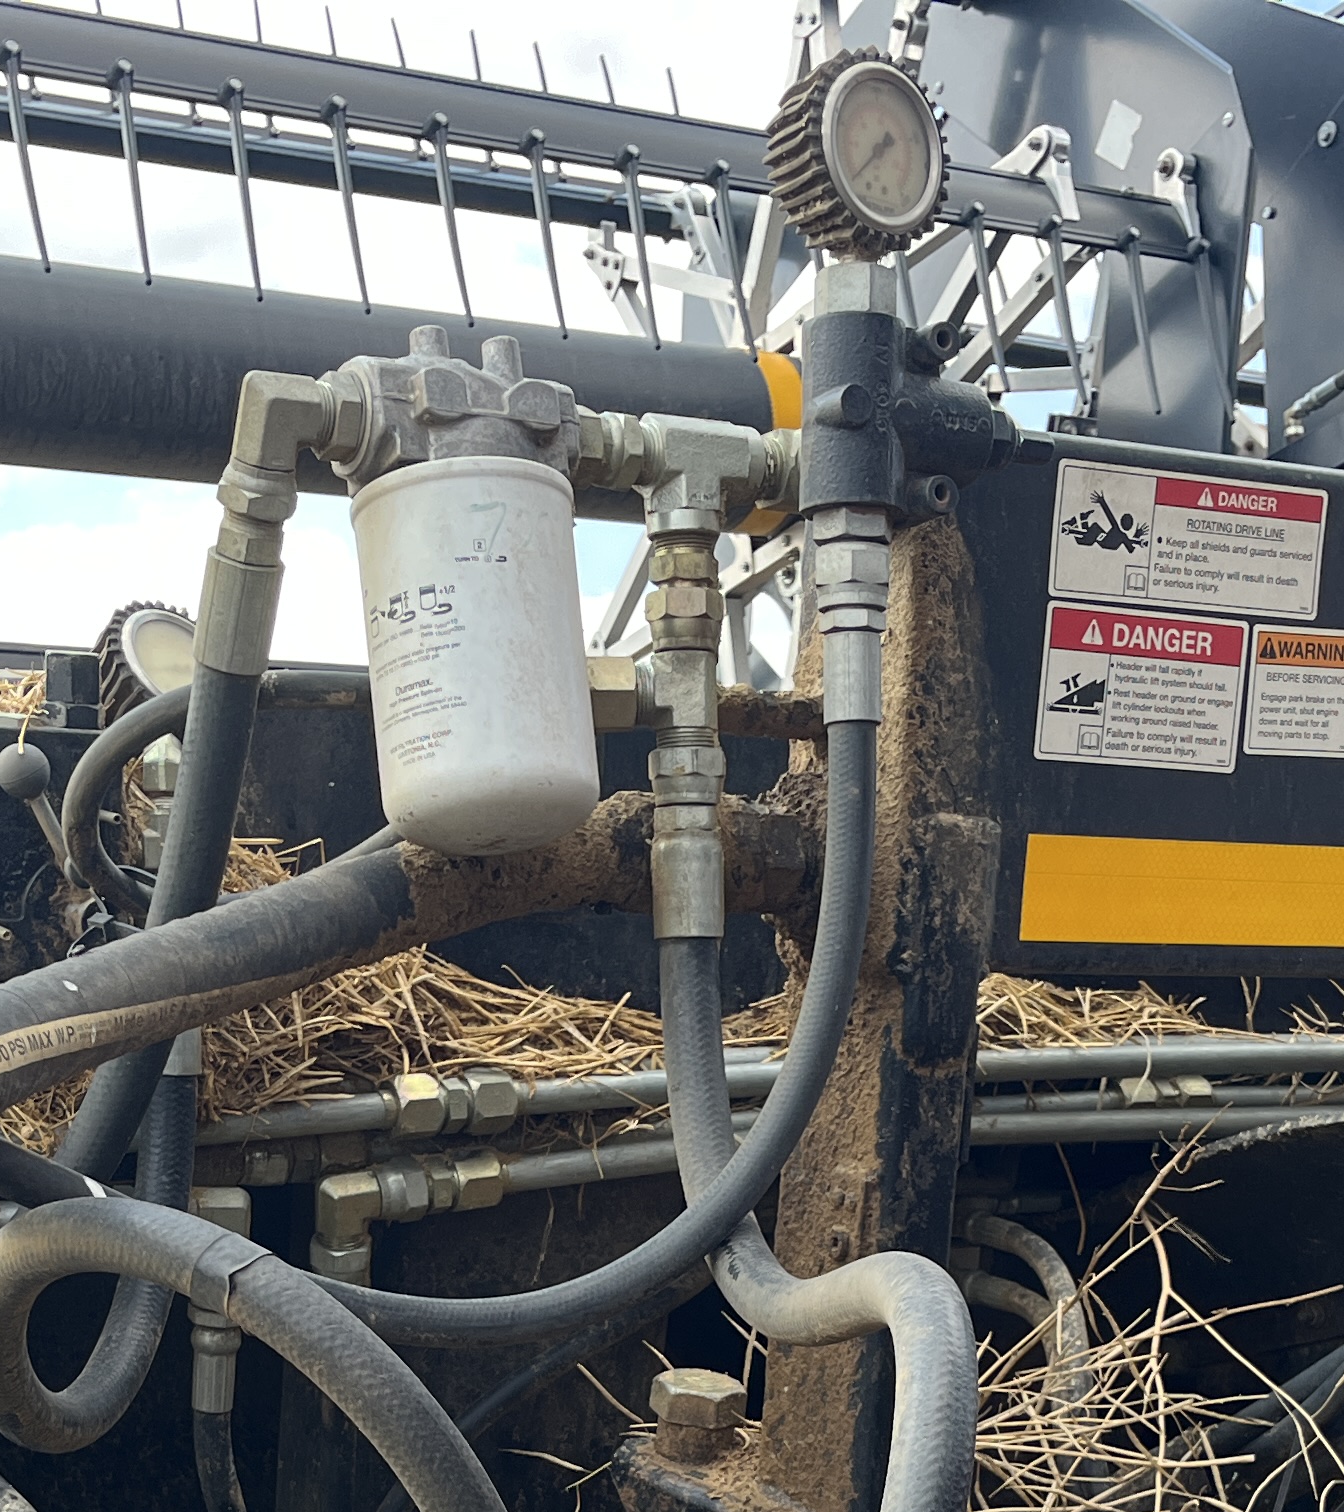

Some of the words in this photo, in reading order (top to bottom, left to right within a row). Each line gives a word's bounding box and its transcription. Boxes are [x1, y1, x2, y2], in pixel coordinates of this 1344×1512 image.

[1217, 490, 1278, 513] DANGER
[1185, 518, 1233, 534] ROTATING
[1234, 523, 1262, 537] DRIVE
[1263, 526, 1285, 539] LINE
[1156, 548, 1173, 559] and
[1174, 550, 1183, 560] in
[1184, 551, 1210, 565] place.
[1164, 536, 1187, 549] Keep
[1189, 538, 1199, 549] all
[1201, 539, 1231, 553] shields
[1231, 543, 1247, 554] and
[1248, 545, 1278, 560] guards
[1278, 548, 1313, 562] serviced
[1153, 562, 1182, 575] Failure
[1183, 565, 1193, 576] to
[1193, 566, 1224, 581] comply
[1225, 570, 1240, 581] will
[1241, 571, 1265, 583] result
[1265, 574, 1274, 584] in
[1274, 575, 1298, 587] death
[1151, 577, 1162, 586] or
[1162, 576, 1194, 590] serious
[1194, 580, 1220, 594] injury.
[1111, 621, 1213, 656] DANGER
[1115, 660, 1142, 671] Header
[1143, 663, 1157, 673] will
[1157, 664, 1170, 674] fall
[1170, 666, 1195, 678] rapidly
[1196, 668, 1202, 677] if
[1265, 671, 1300, 683] BEFORE
[1114, 673, 1149, 686] hydraulic
[1149, 676, 1159, 686] lift
[1159, 678, 1188, 690] system
[1188, 680, 1213, 691] should
[1213, 682, 1227, 692] fail.
[1112, 688, 1130, 698] Rest
[1131, 690, 1158, 701] header
[1158, 693, 1168, 701] on
[1169, 693, 1196, 706] ground
[1197, 697, 1206, 705] or
[1206, 698, 1233, 709] engage
[1259, 691, 1287, 704] Engage
[1287, 693, 1304, 703] park
[1304, 694, 1325, 704] brake
[1325, 696, 1335, 704] on
[1111, 701, 1121, 710] lift
[1122, 701, 1153, 714] cylinder
[1153, 704, 1185, 715] lockouts
[1185, 707, 1206, 717] when
[1258, 706, 1281, 715] power
[1282, 705, 1298, 715] unit,
[1298, 706, 1315, 715] shut
[1315, 708, 1339, 718] engine
[1109, 714, 1140, 726] working
[1141, 716, 1168, 727] around
[1168, 718, 1192, 729] raised
[1192, 720, 1220, 731] header.
[1257, 716, 1278, 726] down
[1278, 717, 1293, 726] and
[1294, 718, 1309, 727] wait
[1309, 719, 1320, 727] for
[1320, 719, 1329, 728] all
[1105, 727, 1135, 739] Failure
[1135, 730, 1145, 740] to
[1146, 731, 1177, 744] comply
[1178, 734, 1193, 744] will
[1193, 735, 1218, 746] result
[1219, 737, 1227, 746] in
[1256, 729, 1283, 740] moving
[1283, 730, 1302, 740] parts
[1303, 731, 1311, 739] to
[1311, 732, 1330, 741] stop.
[1104, 740, 1129, 751] death
[1130, 743, 1140, 752] or
[1140, 743, 1172, 754] serious
[1172, 746, 1198, 758] injury.
[7, 1036, 28, 1058] PSI
[28, 1029, 55, 1051] MAX
